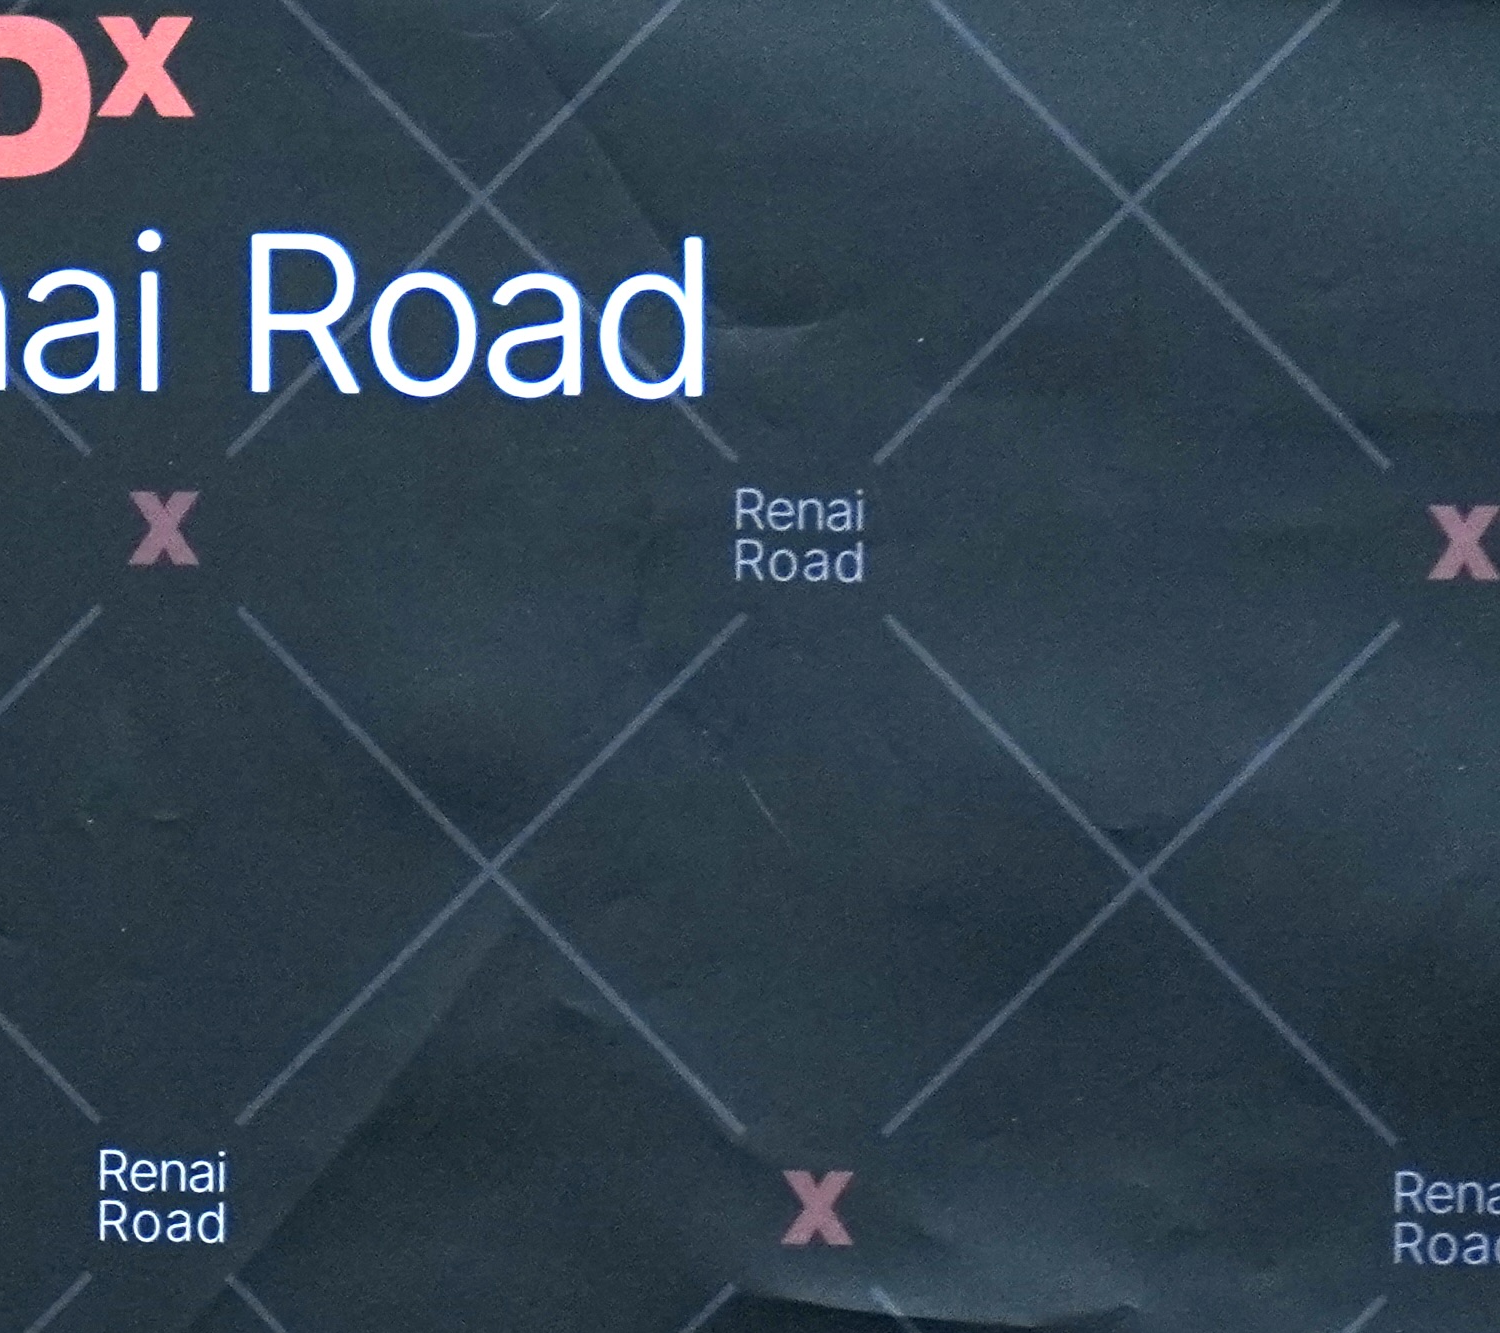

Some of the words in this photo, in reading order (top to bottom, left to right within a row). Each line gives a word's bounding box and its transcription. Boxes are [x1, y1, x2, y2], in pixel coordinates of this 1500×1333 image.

[250, 231, 705, 400] Road
[736, 488, 863, 531] Renai
[736, 539, 863, 583] Road
[100, 1149, 225, 1192] Renai
[100, 1199, 225, 1243] Road
[1394, 1222, 1500, 1265] Roa
